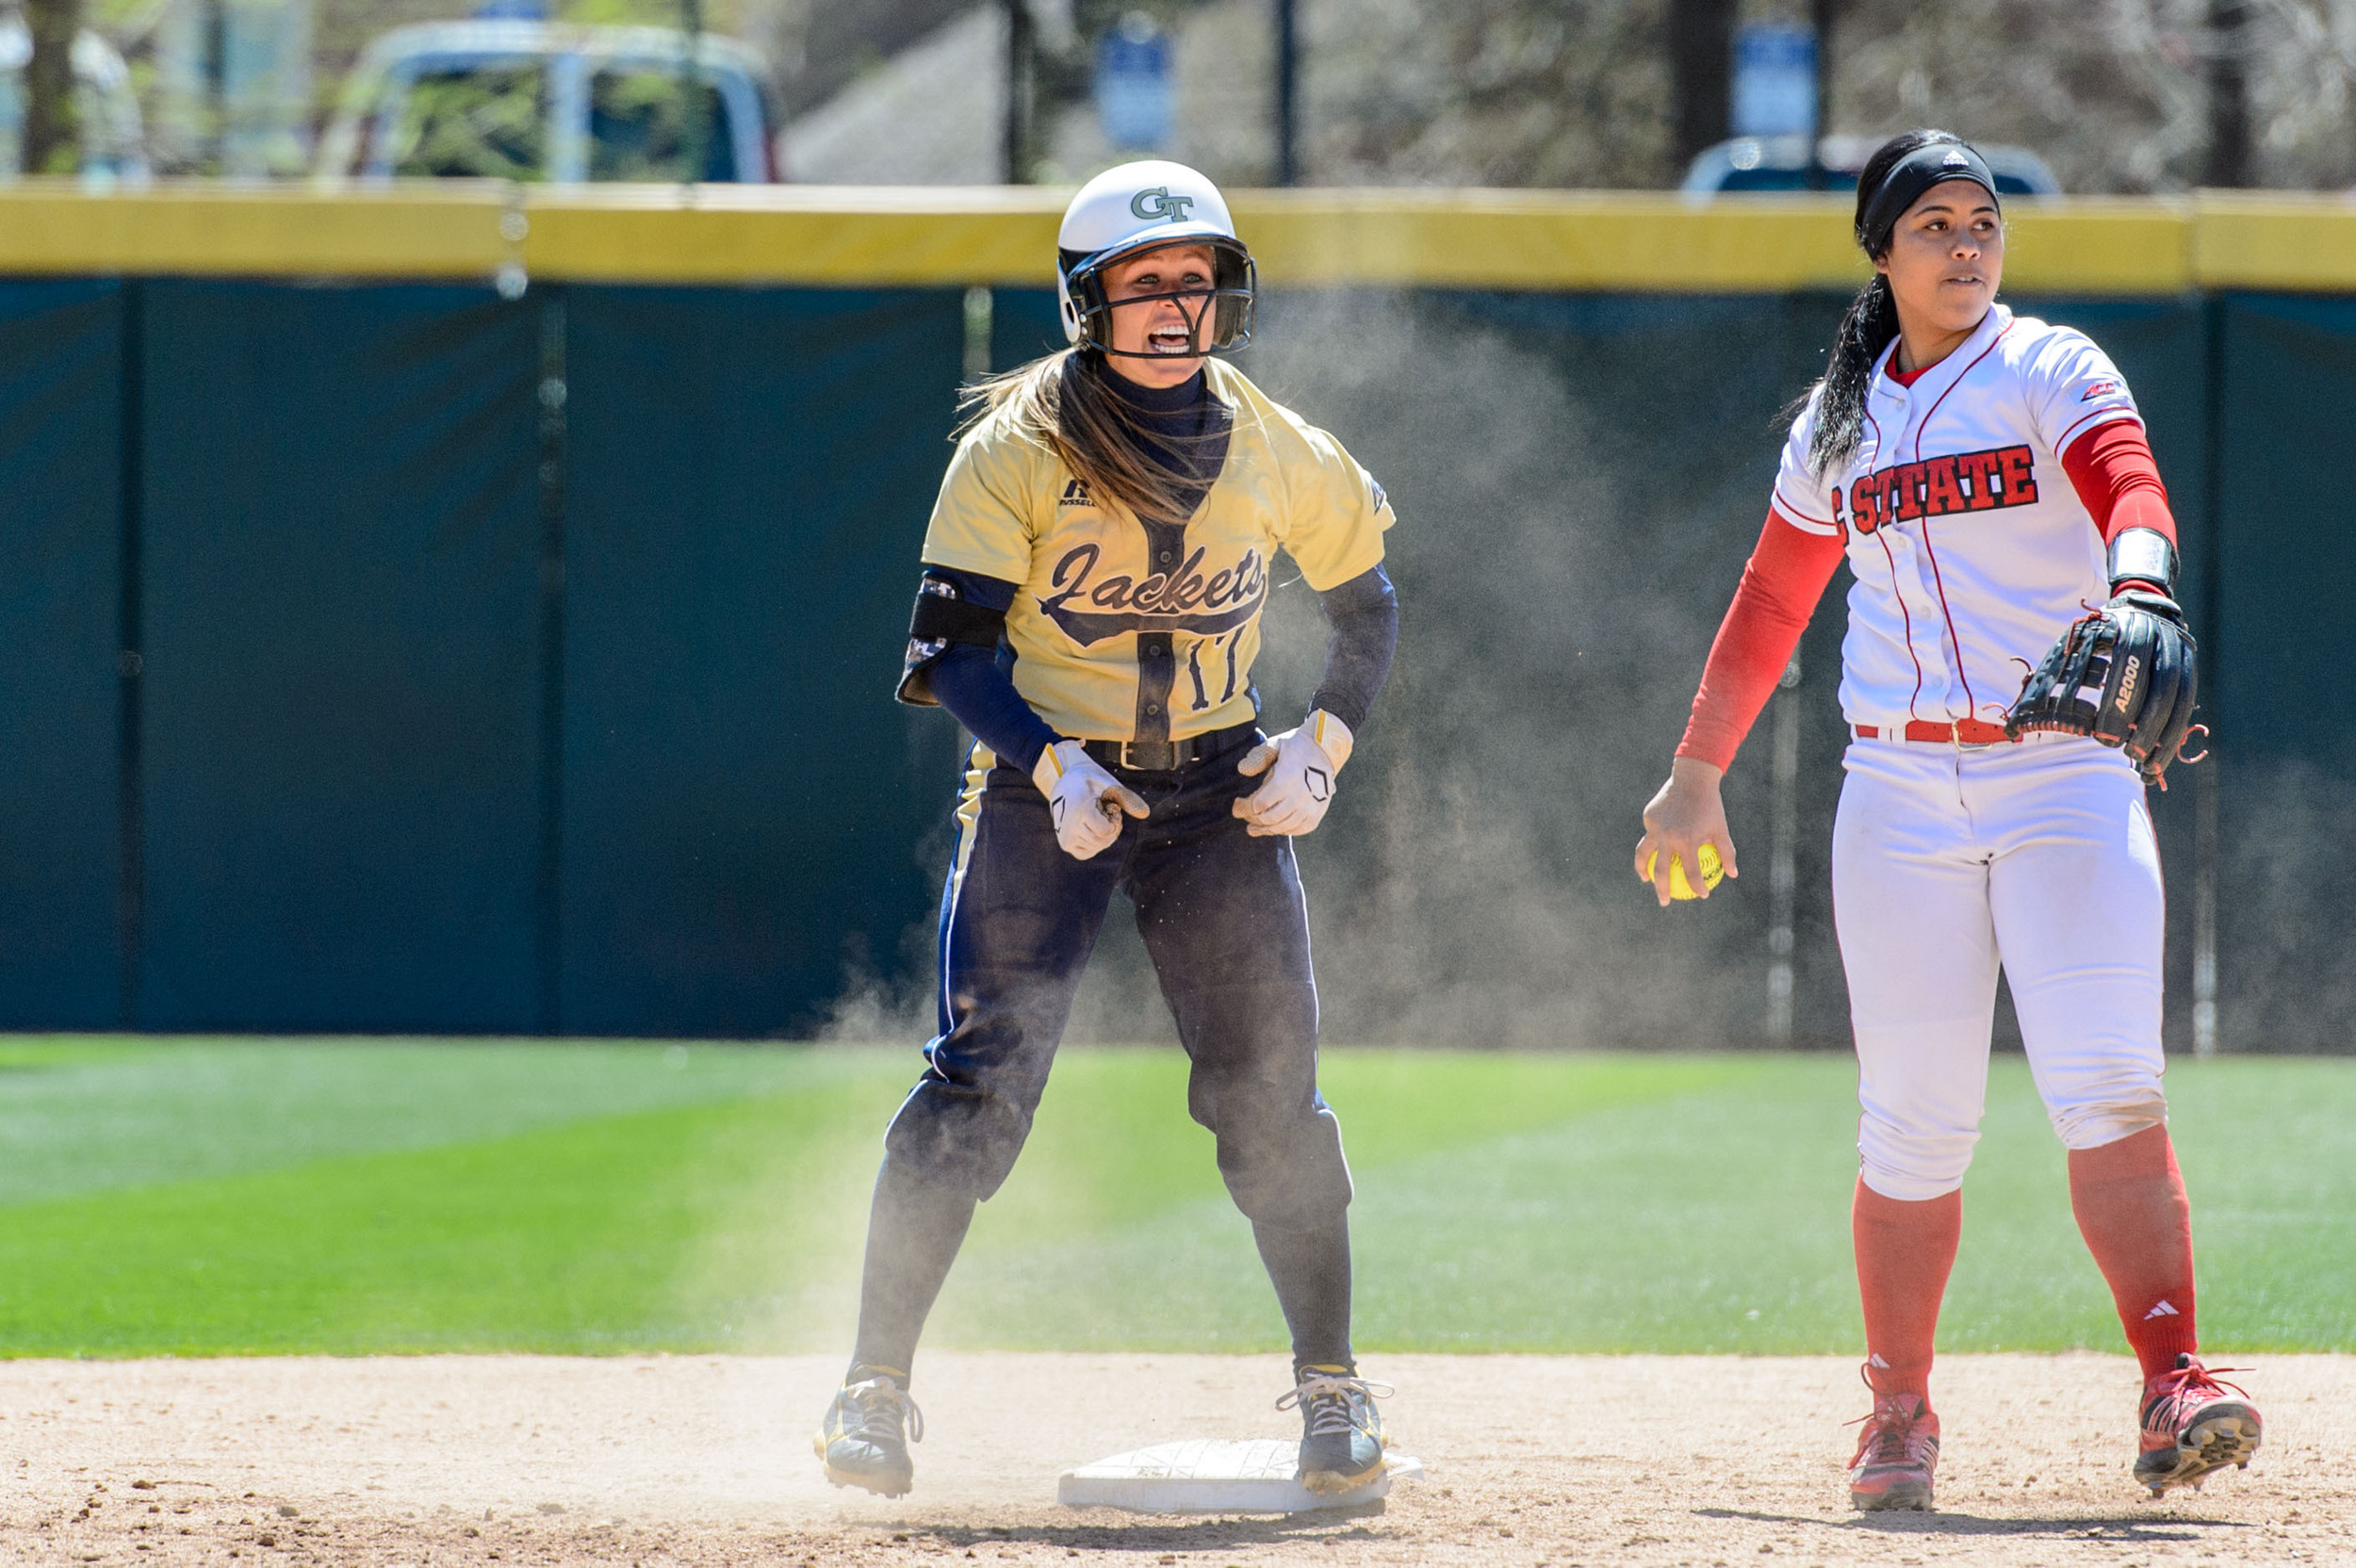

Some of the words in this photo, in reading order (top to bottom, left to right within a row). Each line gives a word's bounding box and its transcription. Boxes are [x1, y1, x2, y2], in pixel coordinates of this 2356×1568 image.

[1131, 187, 1194, 222] GT
[1033, 543, 1267, 618] Jackets
[1187, 623, 1247, 711] 17
[2115, 655, 2140, 713] A2000
